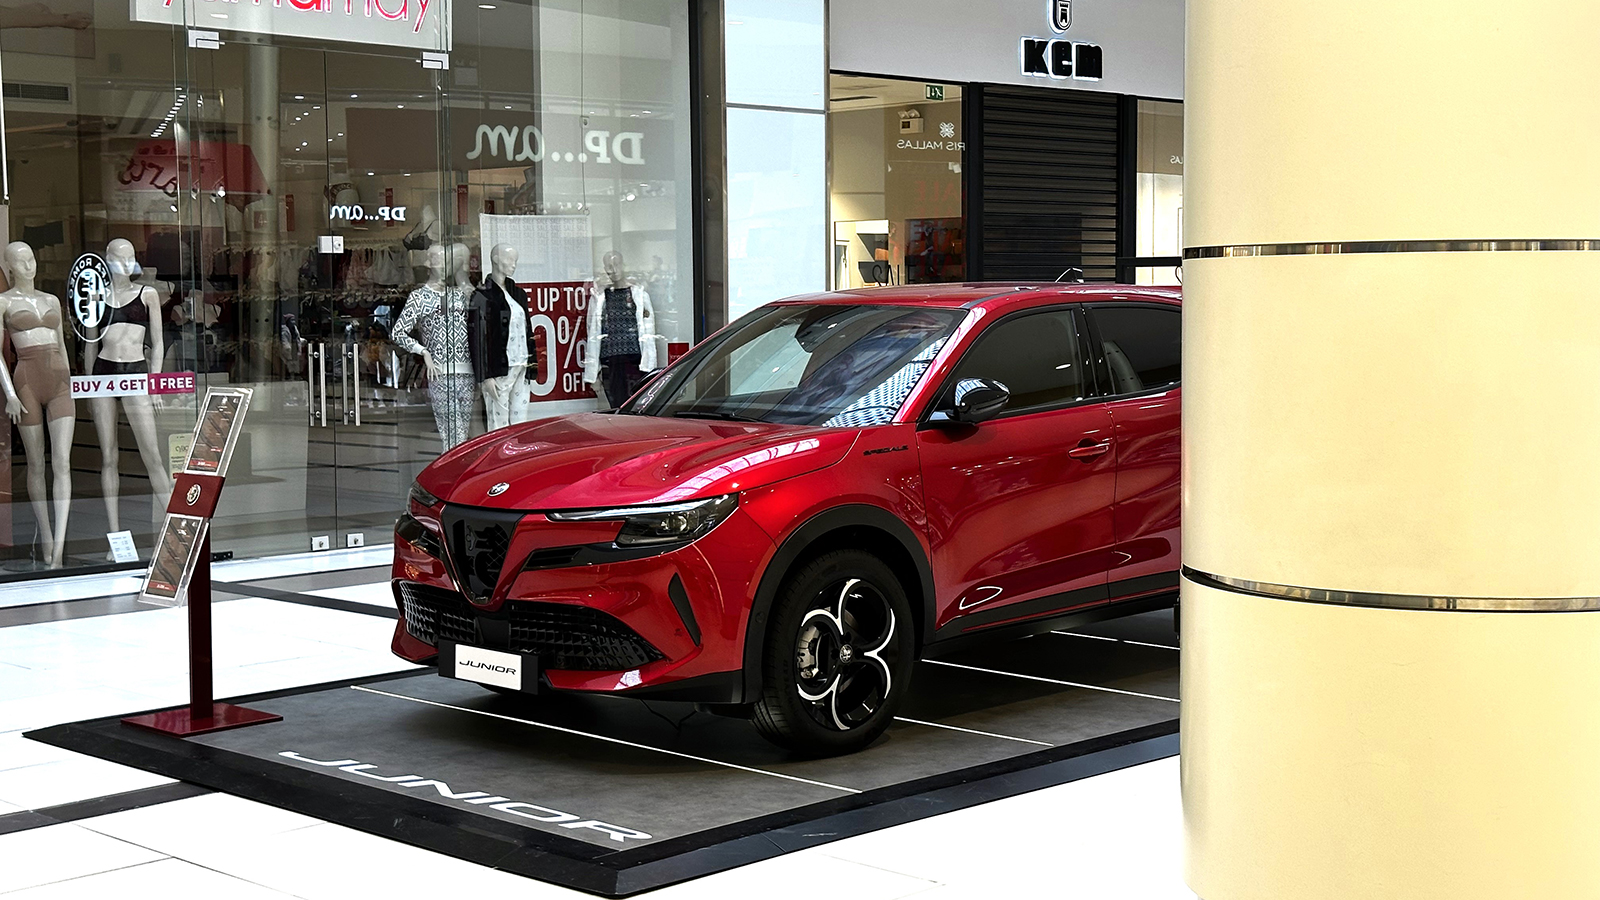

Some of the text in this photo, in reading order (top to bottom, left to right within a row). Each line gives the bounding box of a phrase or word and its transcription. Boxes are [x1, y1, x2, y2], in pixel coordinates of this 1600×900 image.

[537, 287, 560, 312] UP
[563, 286, 586, 311] TO
[529, 314, 588, 397] 0%
[72, 377, 194, 393] BUY 4 GET 1 FREE
[459, 660, 517, 675] JUNIOR
[278, 751, 653, 843] JUNIOR
